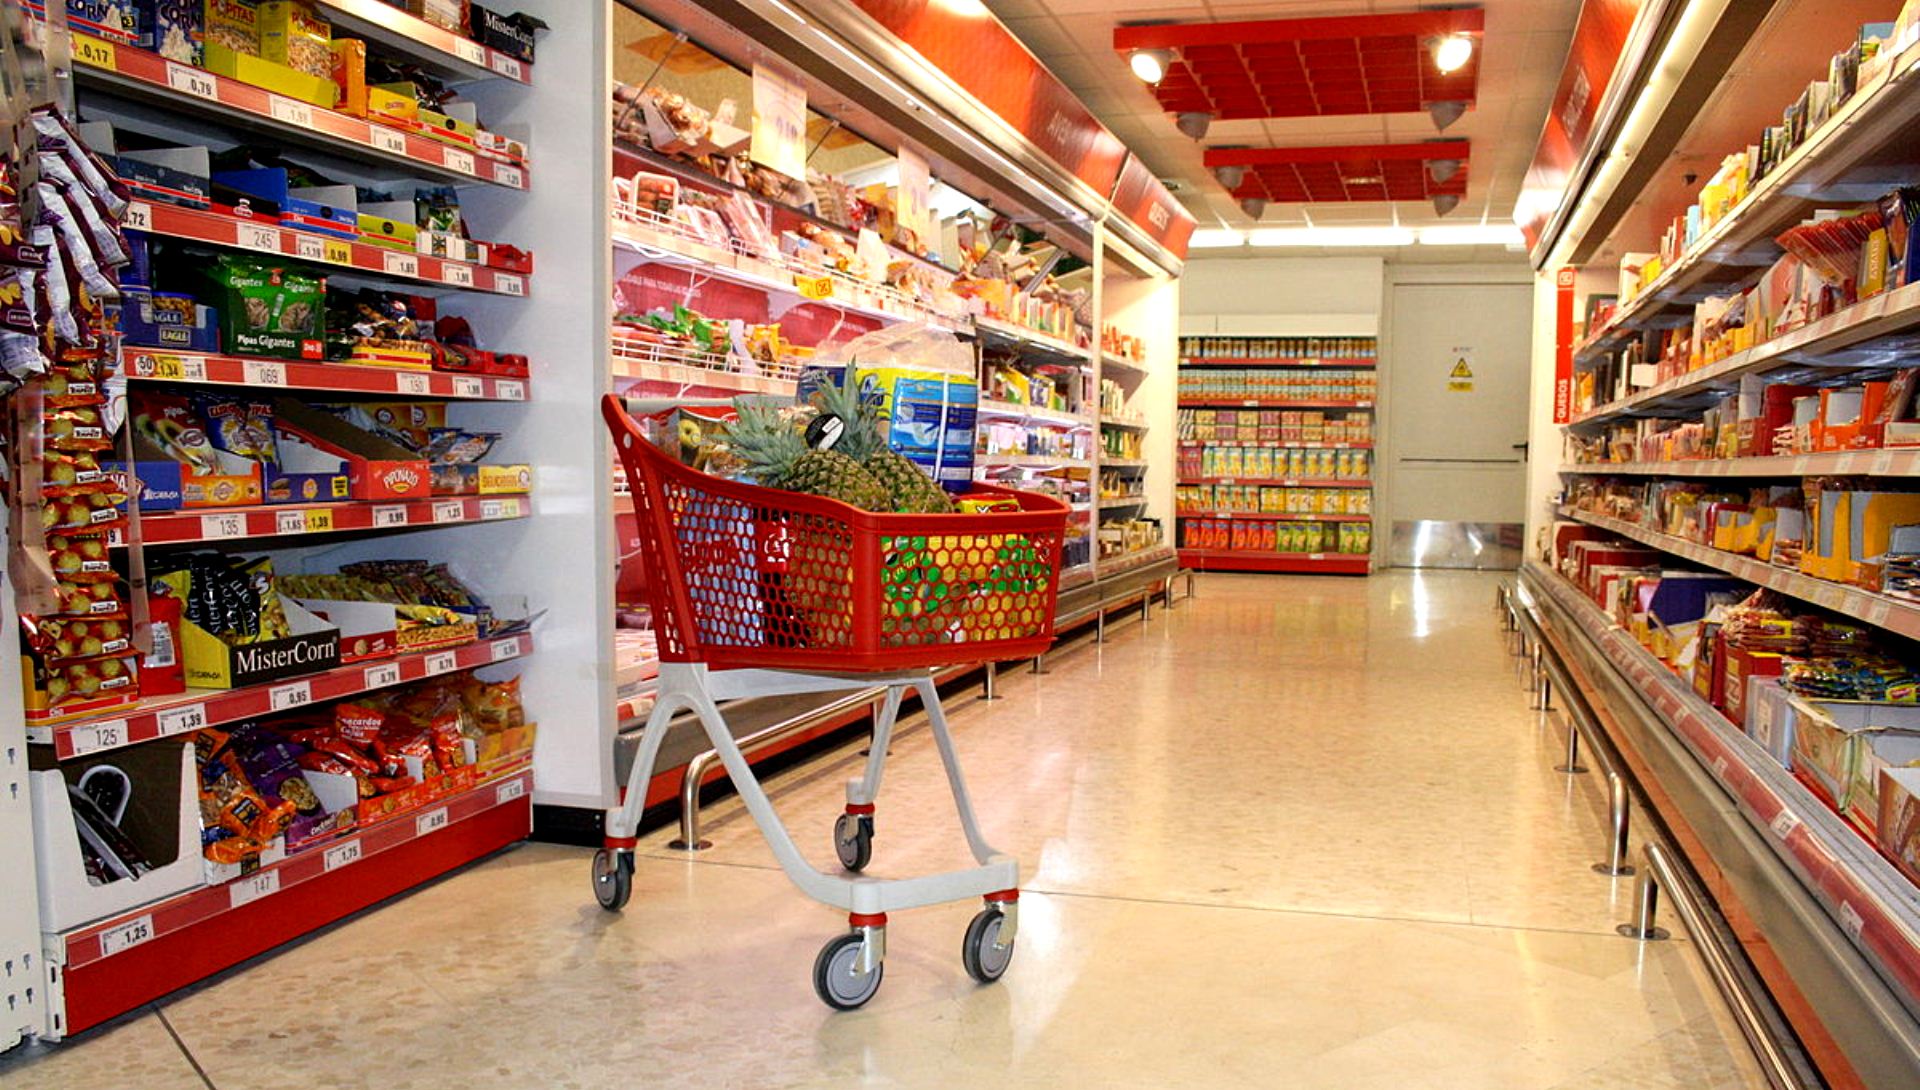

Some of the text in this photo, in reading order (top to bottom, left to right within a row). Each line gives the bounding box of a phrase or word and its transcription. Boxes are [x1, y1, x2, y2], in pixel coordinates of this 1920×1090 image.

[84, 44, 108, 63] 0,17
[237, 334, 295, 349] Pipas Gigantes
[1557, 379, 1568, 418] QUESOS
[383, 468, 419, 489] PIPONAZO
[237, 640, 335, 675] MisterCorn
[125, 925, 147, 943] 1,25
